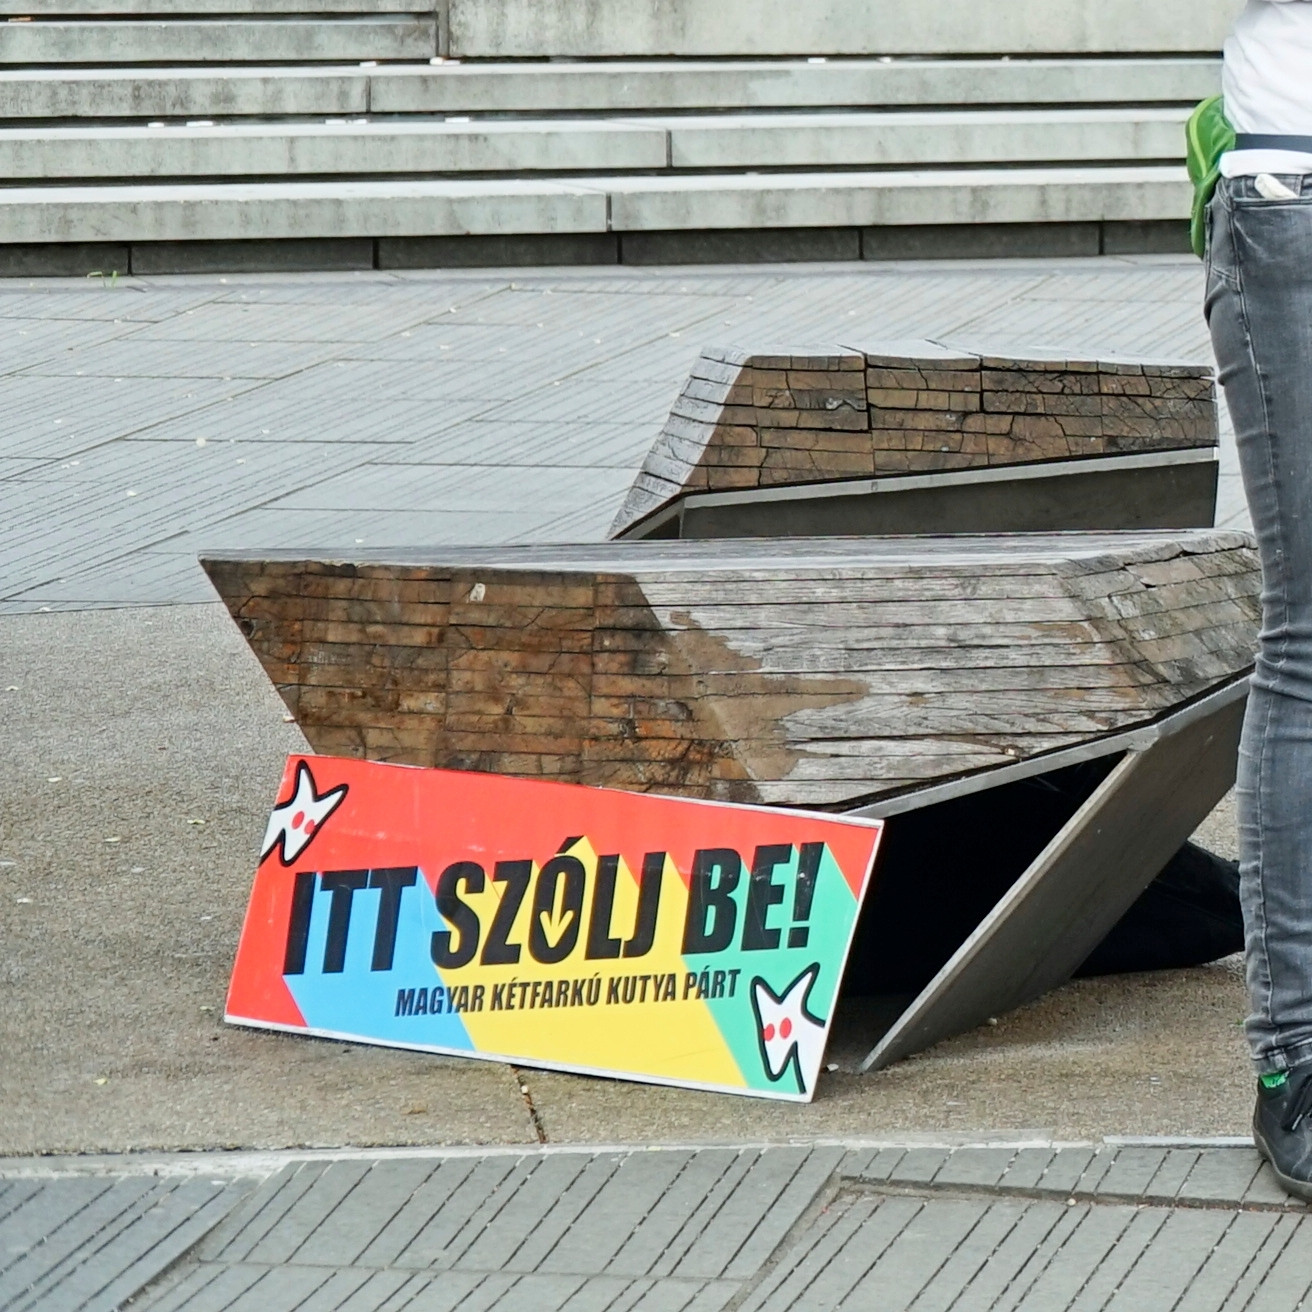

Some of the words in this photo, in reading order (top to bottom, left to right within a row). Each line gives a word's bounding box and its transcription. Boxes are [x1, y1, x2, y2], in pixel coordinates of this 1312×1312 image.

[283, 866, 418, 975] ITT
[430, 836, 667, 969] SZÓLJ
[681, 841, 826, 954] BE!
[394, 986, 485, 1018] MAGYAR
[490, 972, 602, 1013] KÉTFARKÚ
[606, 975, 677, 1004] KUTYA
[682, 968, 741, 1001] PÁRT
